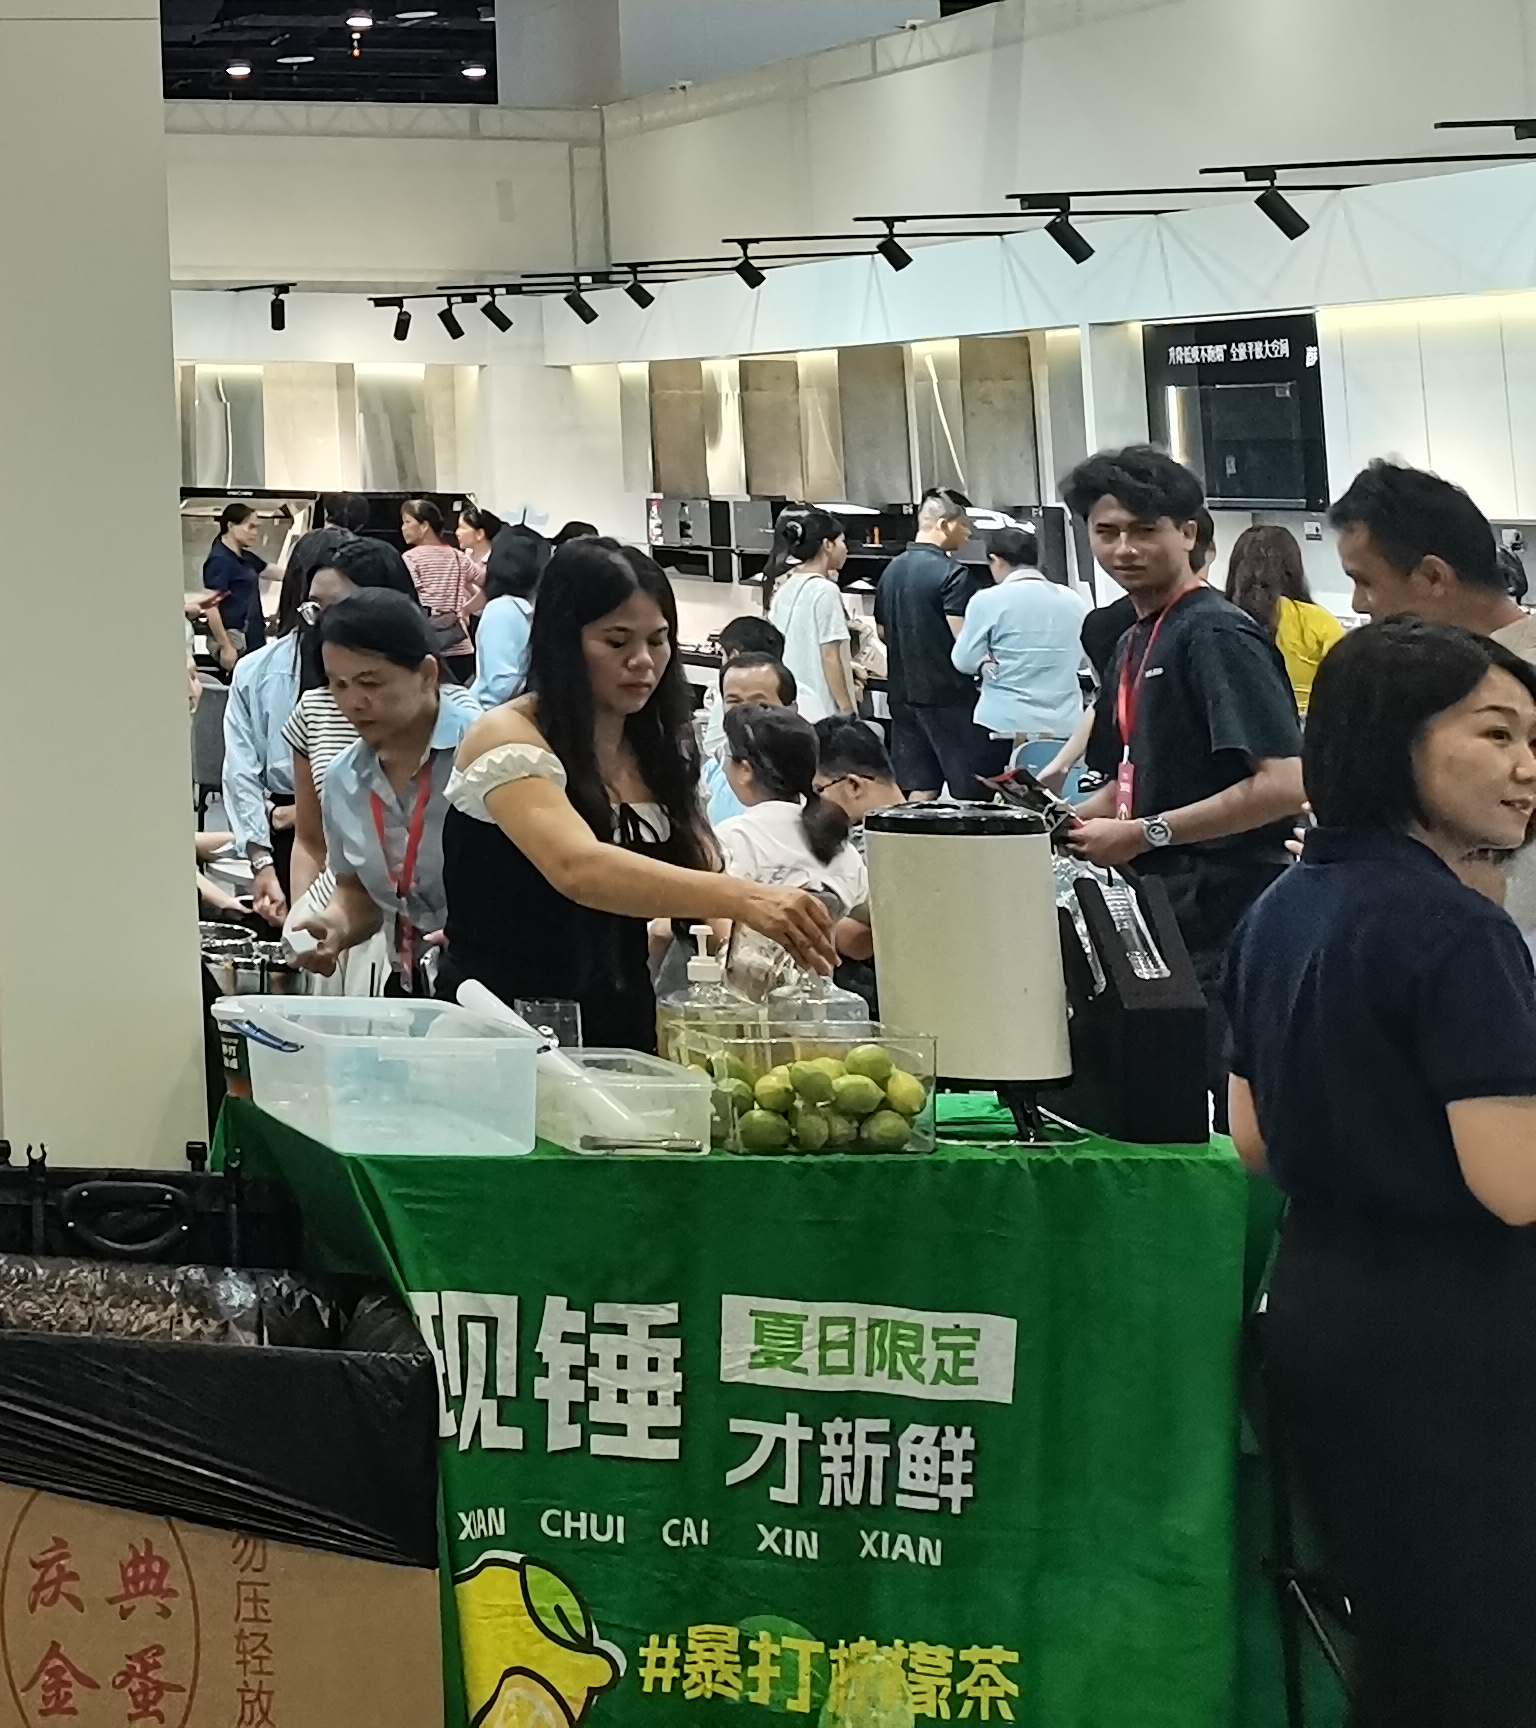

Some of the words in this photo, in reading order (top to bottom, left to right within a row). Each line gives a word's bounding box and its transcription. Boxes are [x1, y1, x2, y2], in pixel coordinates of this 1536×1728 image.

[410, 1288, 683, 1459] 现锤
[746, 1306, 982, 1388] 夏日限定
[726, 1410, 976, 1515] 才新鲜
[27, 1534, 180, 1622] 庆典
[456, 1507, 507, 1543] XIAN
[539, 1507, 626, 1545] CHUI
[661, 1515, 709, 1548] CAI
[756, 1522, 821, 1561] XIN
[858, 1528, 945, 1566] XIAN
[20, 1638, 188, 1724] 金蛋
